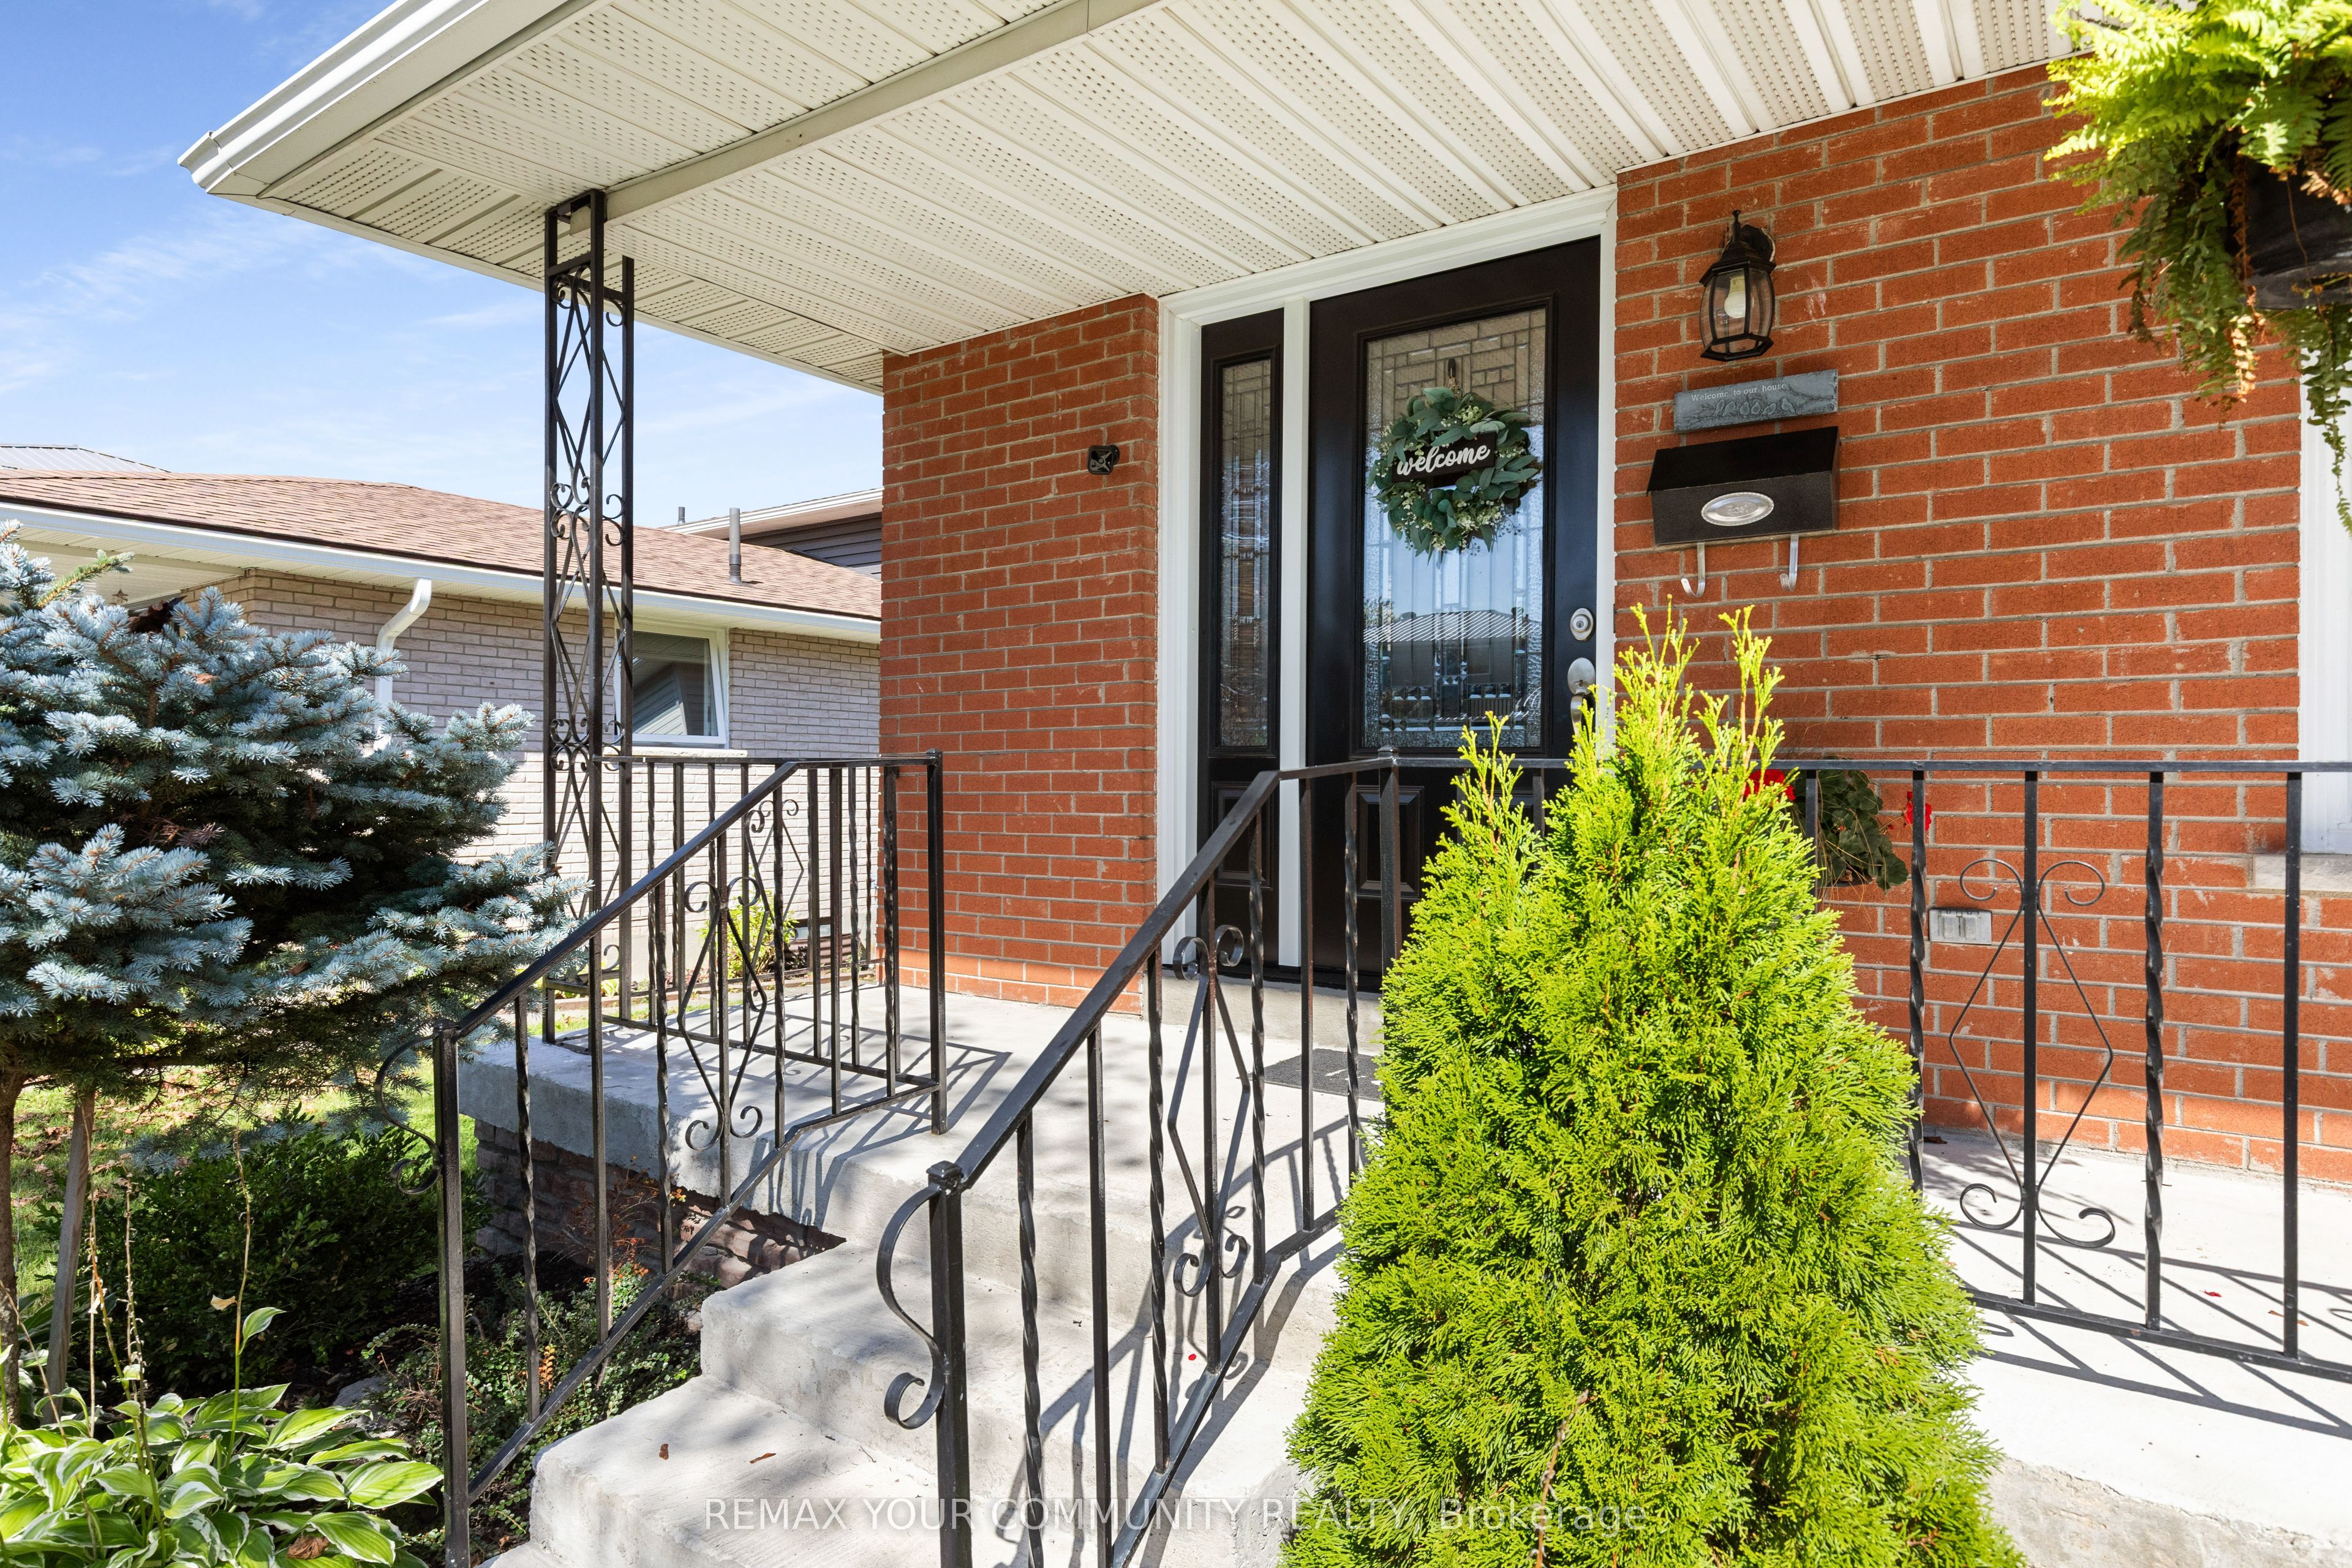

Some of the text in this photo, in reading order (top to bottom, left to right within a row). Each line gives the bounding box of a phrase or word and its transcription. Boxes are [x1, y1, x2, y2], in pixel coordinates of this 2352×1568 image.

[1691, 391, 1729, 402] Welcome
[1743, 386, 1758, 395] our
[1762, 383, 1787, 392] house
[1396, 445, 1491, 476] welcome
